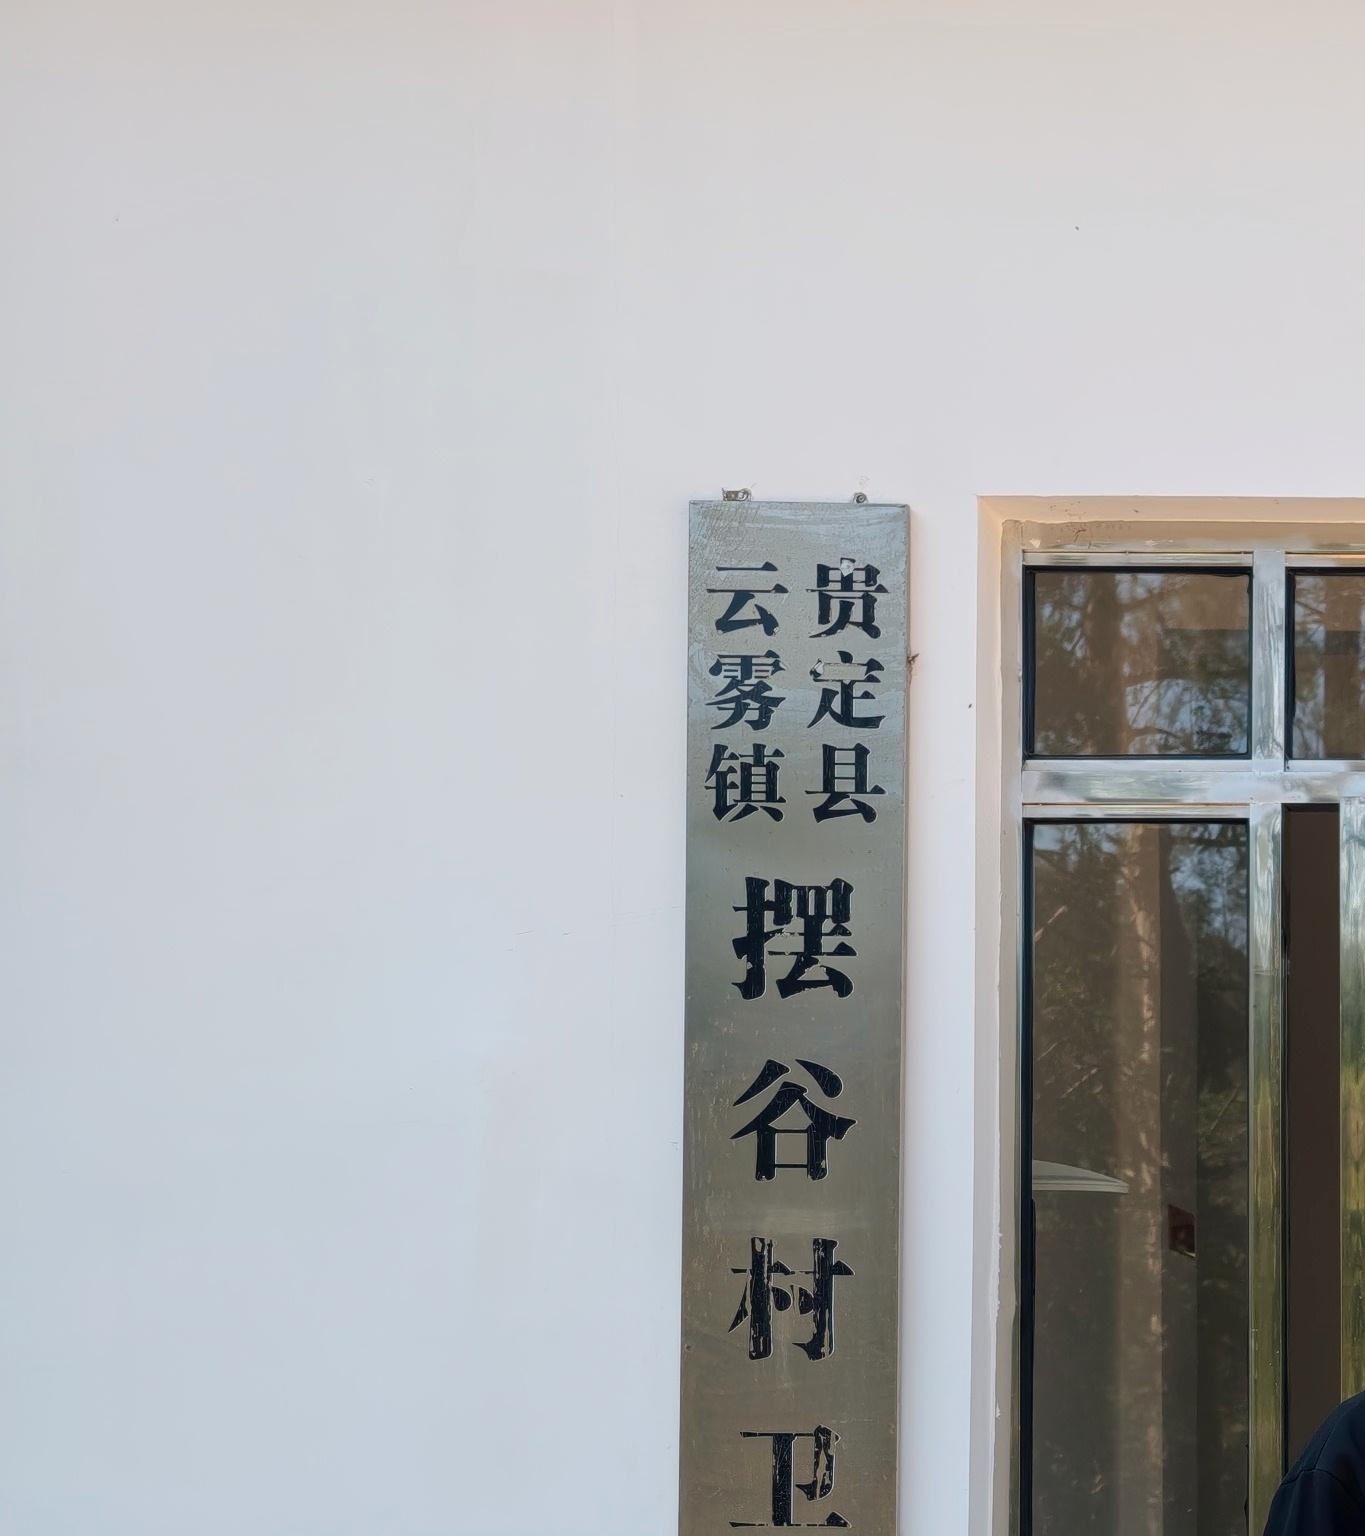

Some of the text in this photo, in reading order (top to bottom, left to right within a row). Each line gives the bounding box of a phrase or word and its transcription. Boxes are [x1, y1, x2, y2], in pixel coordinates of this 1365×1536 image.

[704, 560, 789, 824] 云雾镇
[805, 556, 889, 825] 贵定县
